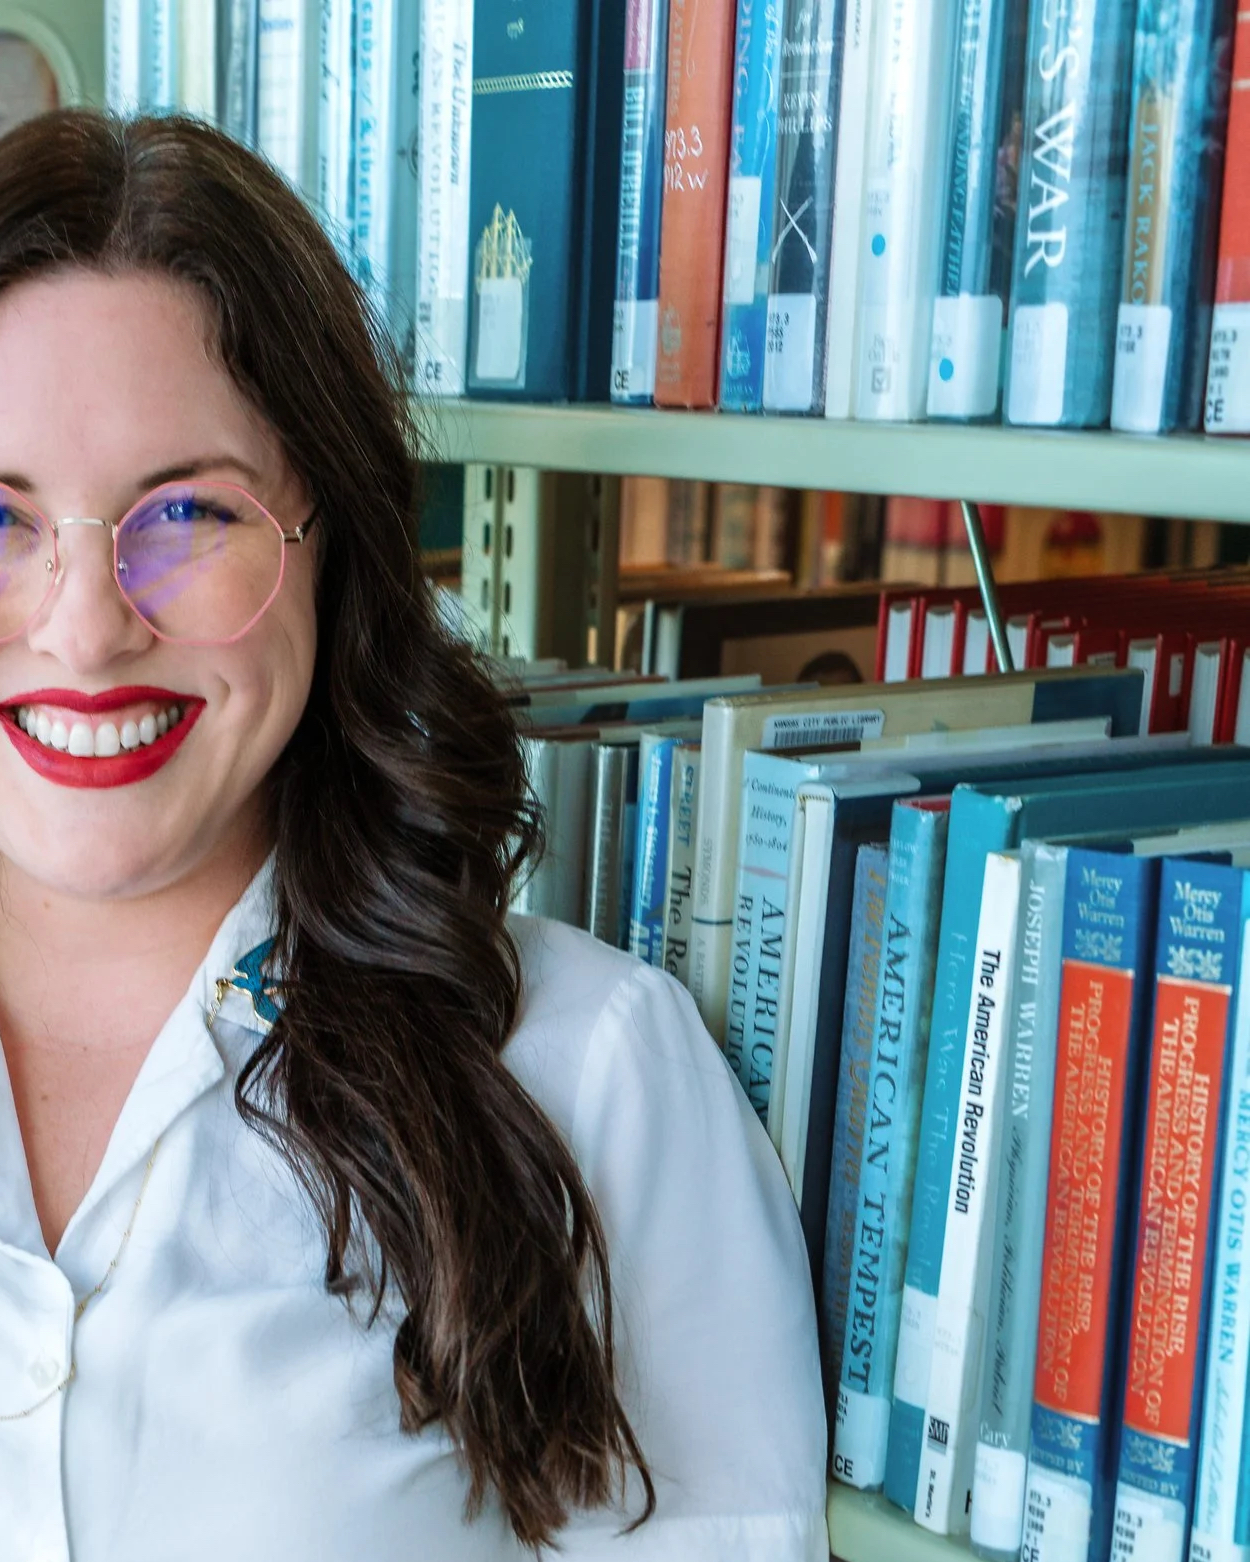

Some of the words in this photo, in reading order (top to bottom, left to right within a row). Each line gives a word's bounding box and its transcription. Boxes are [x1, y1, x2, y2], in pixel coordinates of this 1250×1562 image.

[1024, 112, 1078, 279] WAR
[614, 369, 630, 391] CE
[677, 764, 694, 849] STREET
[669, 866, 692, 926] The
[1082, 866, 1123, 893] Mercy
[1088, 889, 1117, 910] Otis
[1175, 880, 1222, 909] Mercy
[1021, 879, 1045, 986] JOSEPH
[1077, 902, 1125, 929] Warren
[1169, 916, 1225, 944] Warren
[1183, 903, 1215, 924] Otis
[981, 948, 1001, 988] The
[863, 912, 911, 1175] AMERICAN
[968, 992, 997, 1097] American
[1012, 1001, 1038, 1119] WARREN
[1068, 1002, 1087, 1059] THE
[1078, 979, 1105, 1115] PROGRESS
[1161, 1019, 1181, 1077] THE
[1171, 995, 1200, 1135] PROGRESS
[1055, 1062, 1081, 1204] AMERICAN
[1088, 1055, 1113, 1172] HISTORY
[1181, 1071, 1211, 1193] HISTORY
[954, 1100, 985, 1215] Revolution
[1071, 1118, 1091, 1182] AND
[1147, 1078, 1173, 1226] AMERICAN
[1165, 1138, 1185, 1201] AND
[1085, 1174, 1102, 1208] OF
[1180, 1195, 1198, 1228] OF
[1226, 1189, 1247, 1250] OTIS
[1059, 1184, 1085, 1362] TERMINATION
[1080, 1212, 1098, 1271] THE
[1174, 1232, 1195, 1290] THE
[847, 1192, 887, 1395] TEMPEST
[1042, 1206, 1067, 1373] REVOLUTION
[1131, 1227, 1162, 1396] REVOLUTION
[1147, 1203, 1180, 1387] TERMINATION
[1218, 1262, 1242, 1364] WARREN
[1053, 1368, 1070, 1403] OF
[1144, 1388, 1162, 1426] OF
[834, 1454, 854, 1478] CE
